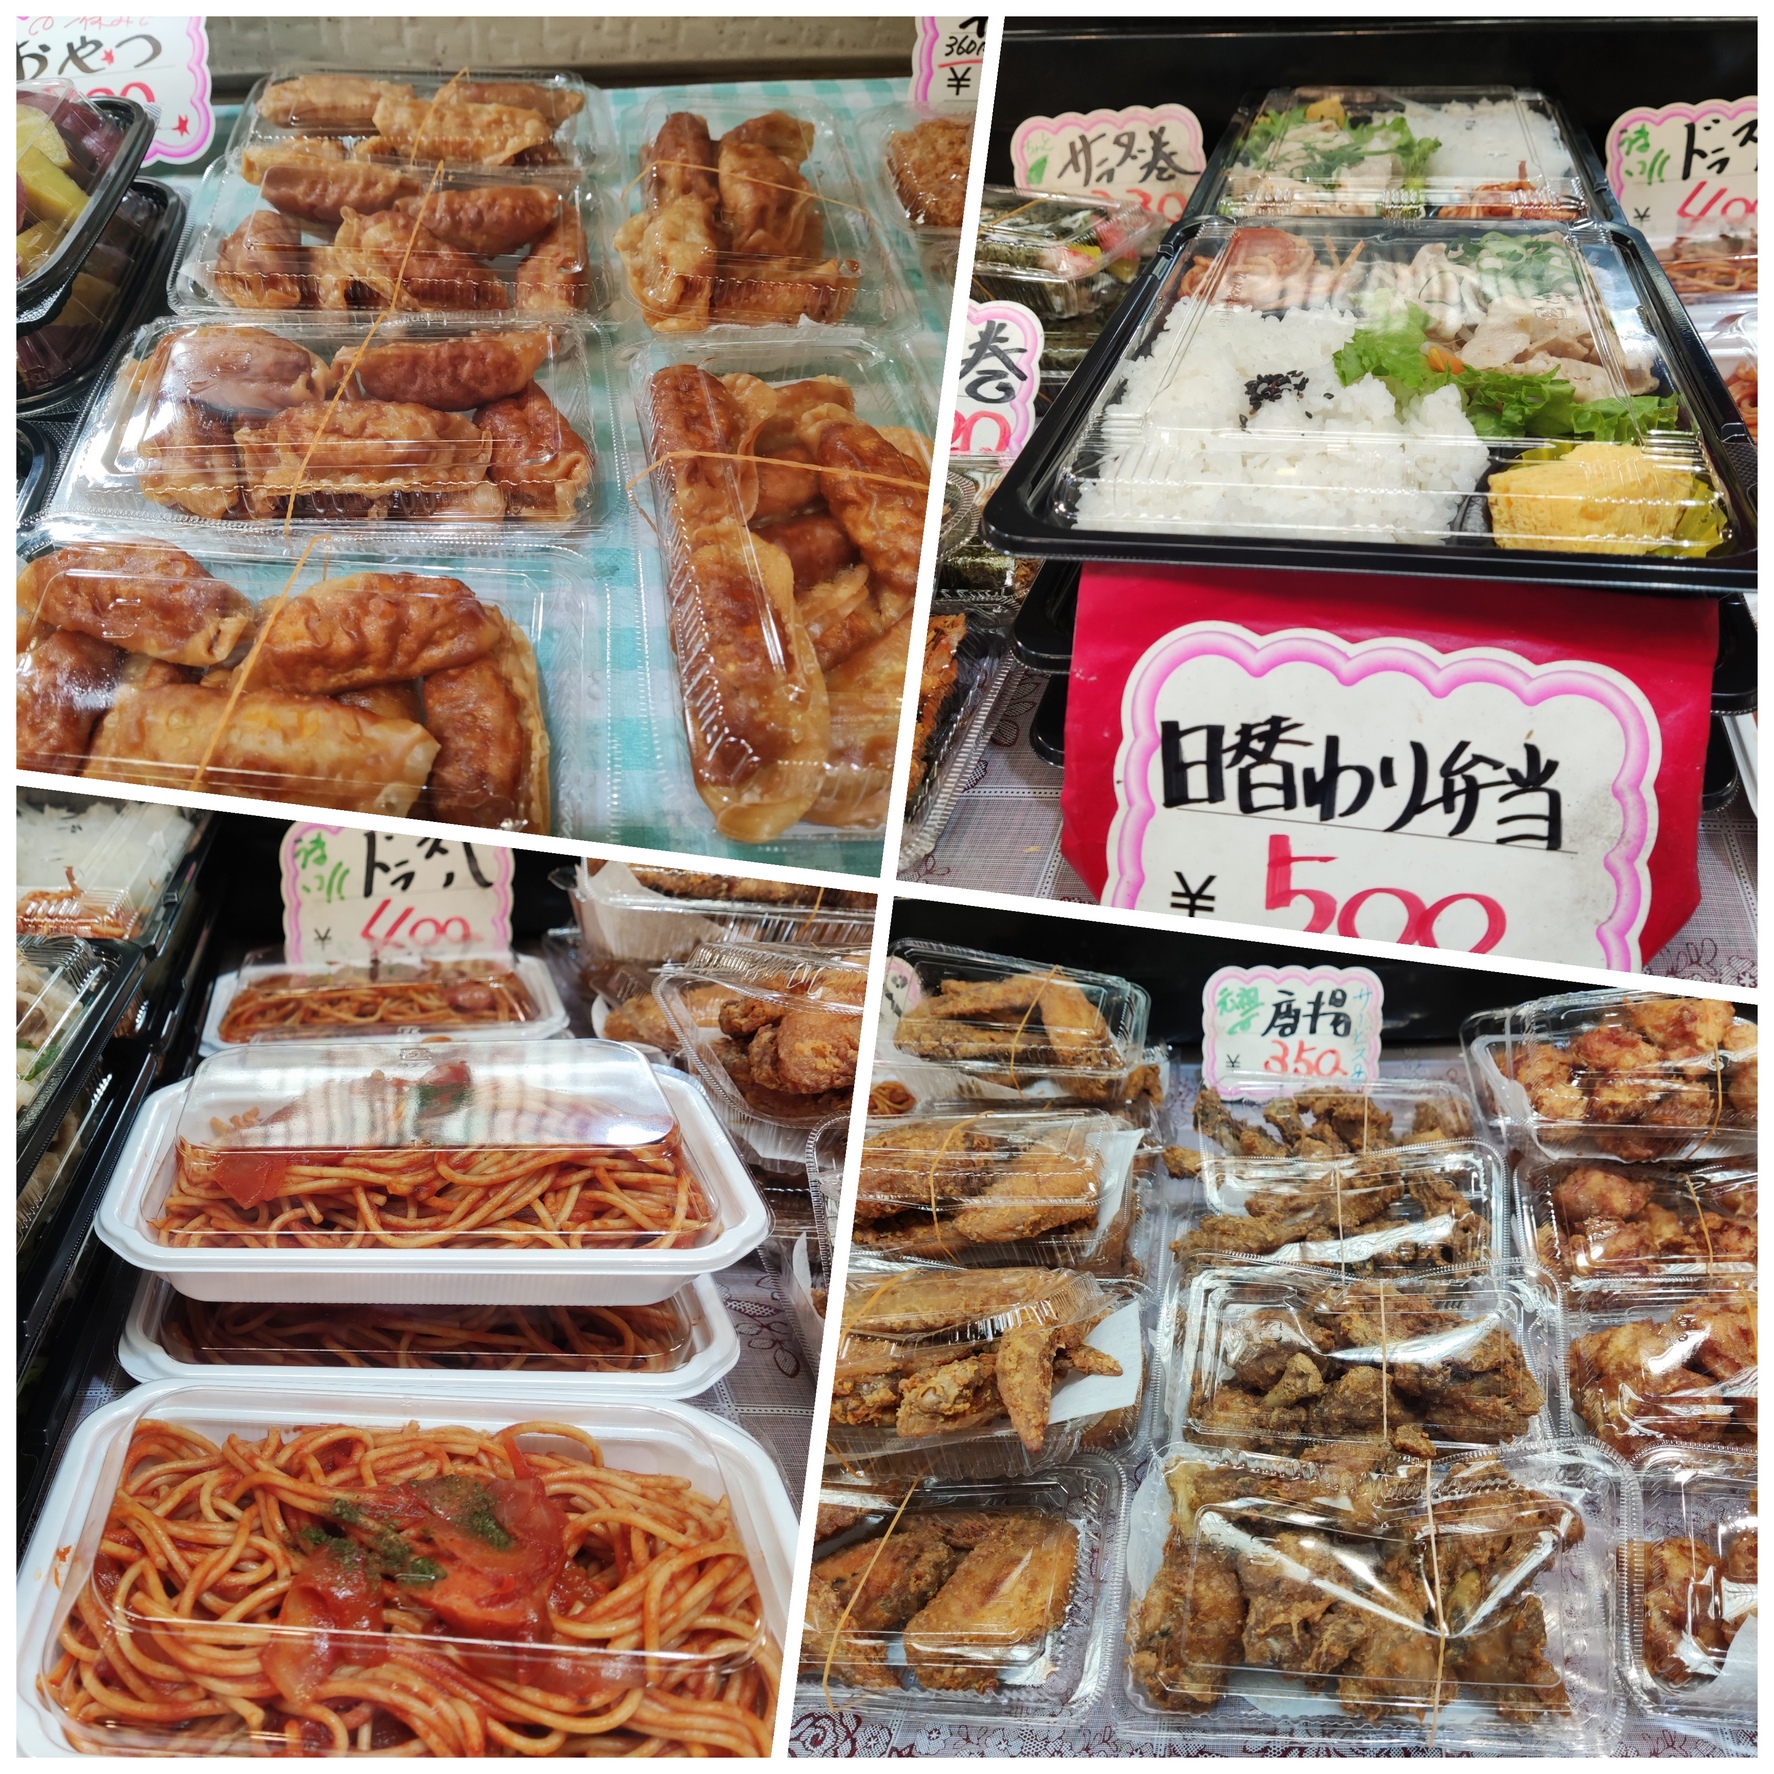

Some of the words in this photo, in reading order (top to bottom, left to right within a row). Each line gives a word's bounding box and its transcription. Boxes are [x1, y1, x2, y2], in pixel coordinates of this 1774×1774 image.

[16, 35, 162, 80] おやつ
[1682, 118, 1757, 181] ドラス
[1676, 180, 1757, 234] 40
[1161, 714, 1562, 850] 日替わり弁当
[1265, 834, 1507, 954] 500
[360, 898, 474, 949] 400
[1264, 1039, 1348, 1077] 350
